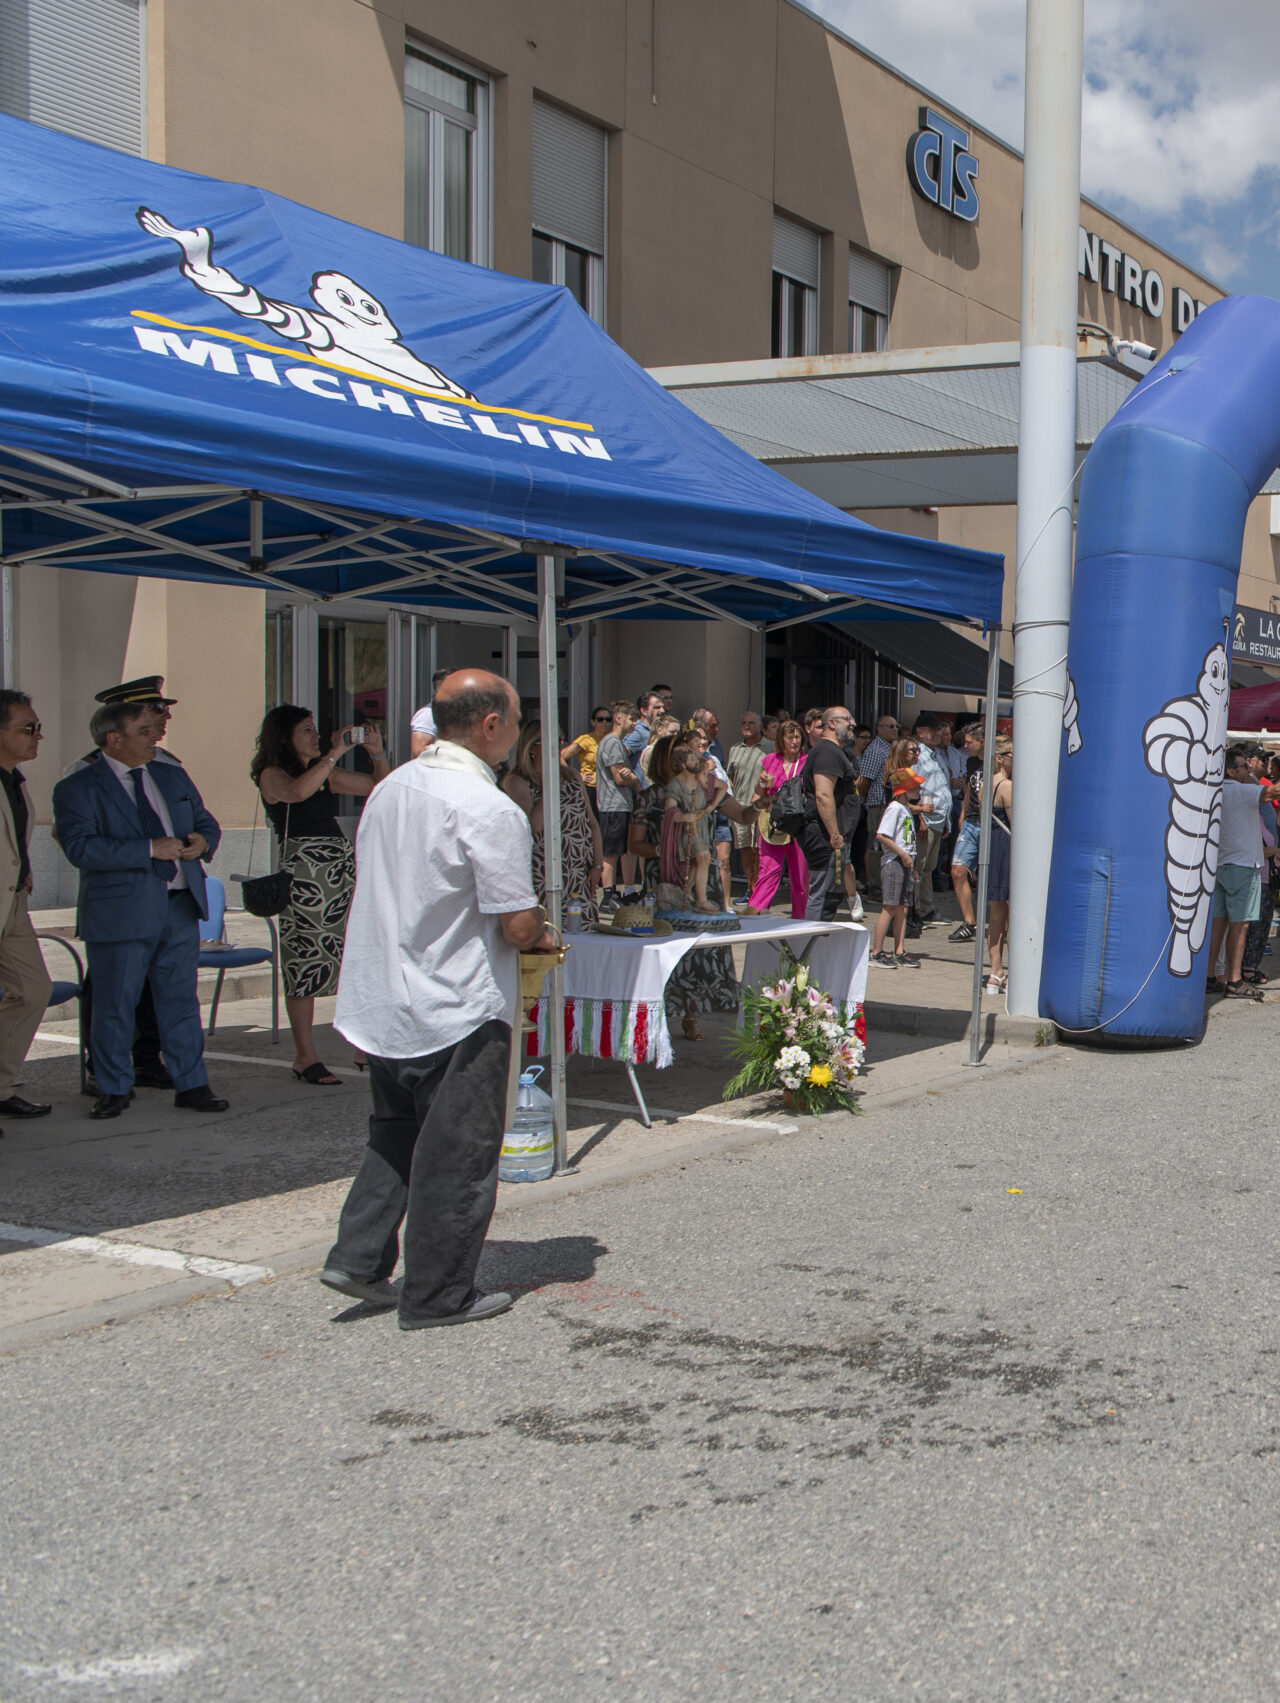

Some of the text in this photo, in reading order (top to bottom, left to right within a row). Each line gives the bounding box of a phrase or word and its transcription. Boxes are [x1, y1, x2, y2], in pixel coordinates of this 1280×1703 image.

[910, 107, 979, 221] CTS
[1078, 225, 1165, 318] NTRO
[133, 325, 613, 461] MICHELIN
[1260, 618, 1275, 639] LA
